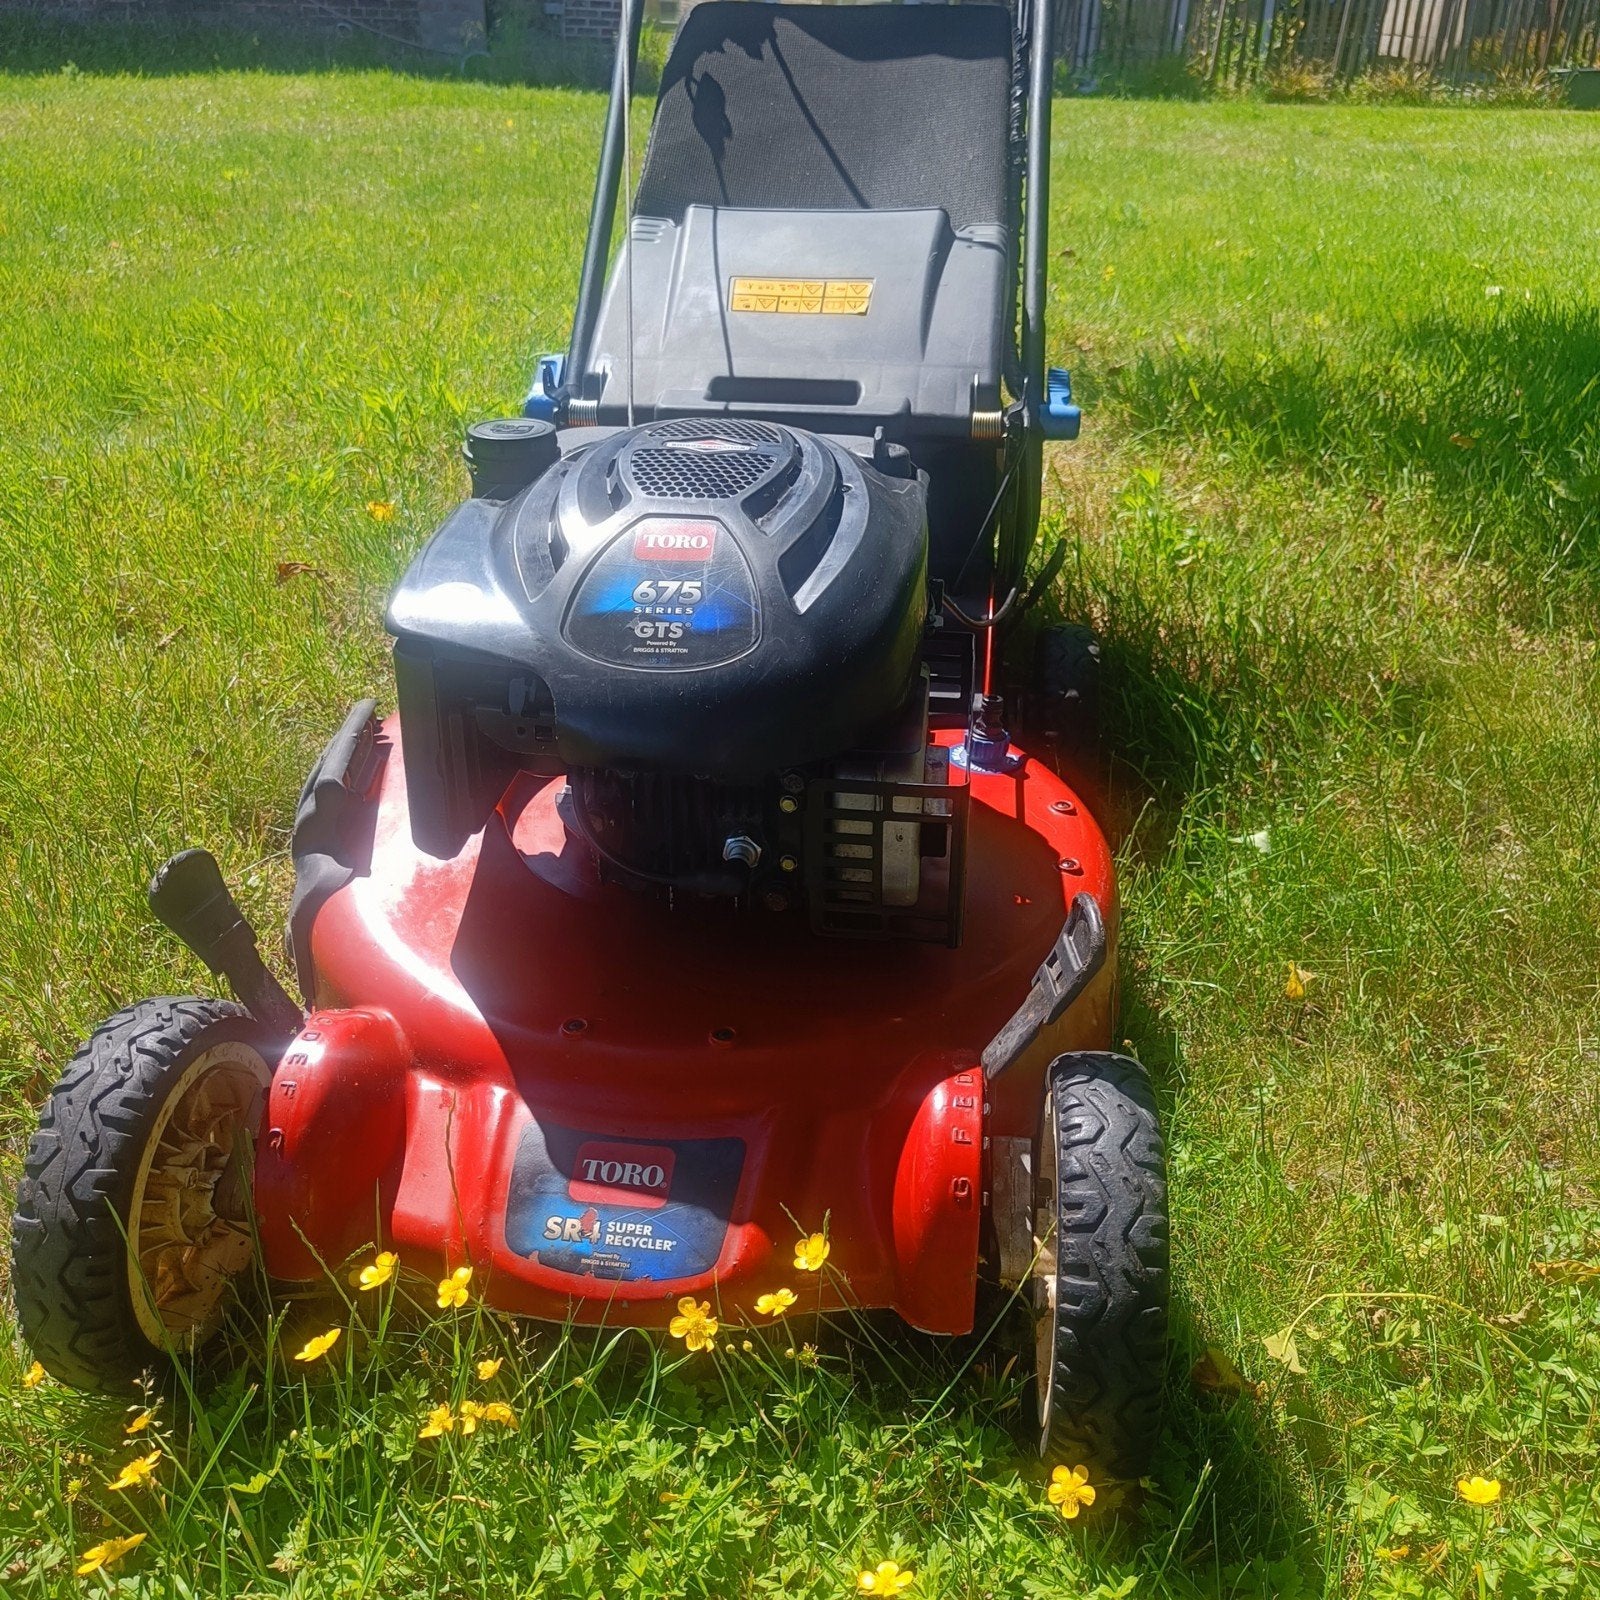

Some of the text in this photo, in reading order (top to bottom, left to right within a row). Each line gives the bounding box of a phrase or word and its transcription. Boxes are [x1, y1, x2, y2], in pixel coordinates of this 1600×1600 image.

[643, 534, 709, 549] TORO
[632, 580, 702, 604] 675
[633, 606, 693, 615] SERIES
[634, 621, 684, 639] GTS
[582, 1159, 665, 1187] TORO
[607, 1221, 652, 1236] SUPER
[605, 1234, 676, 1251] RECYCLER
